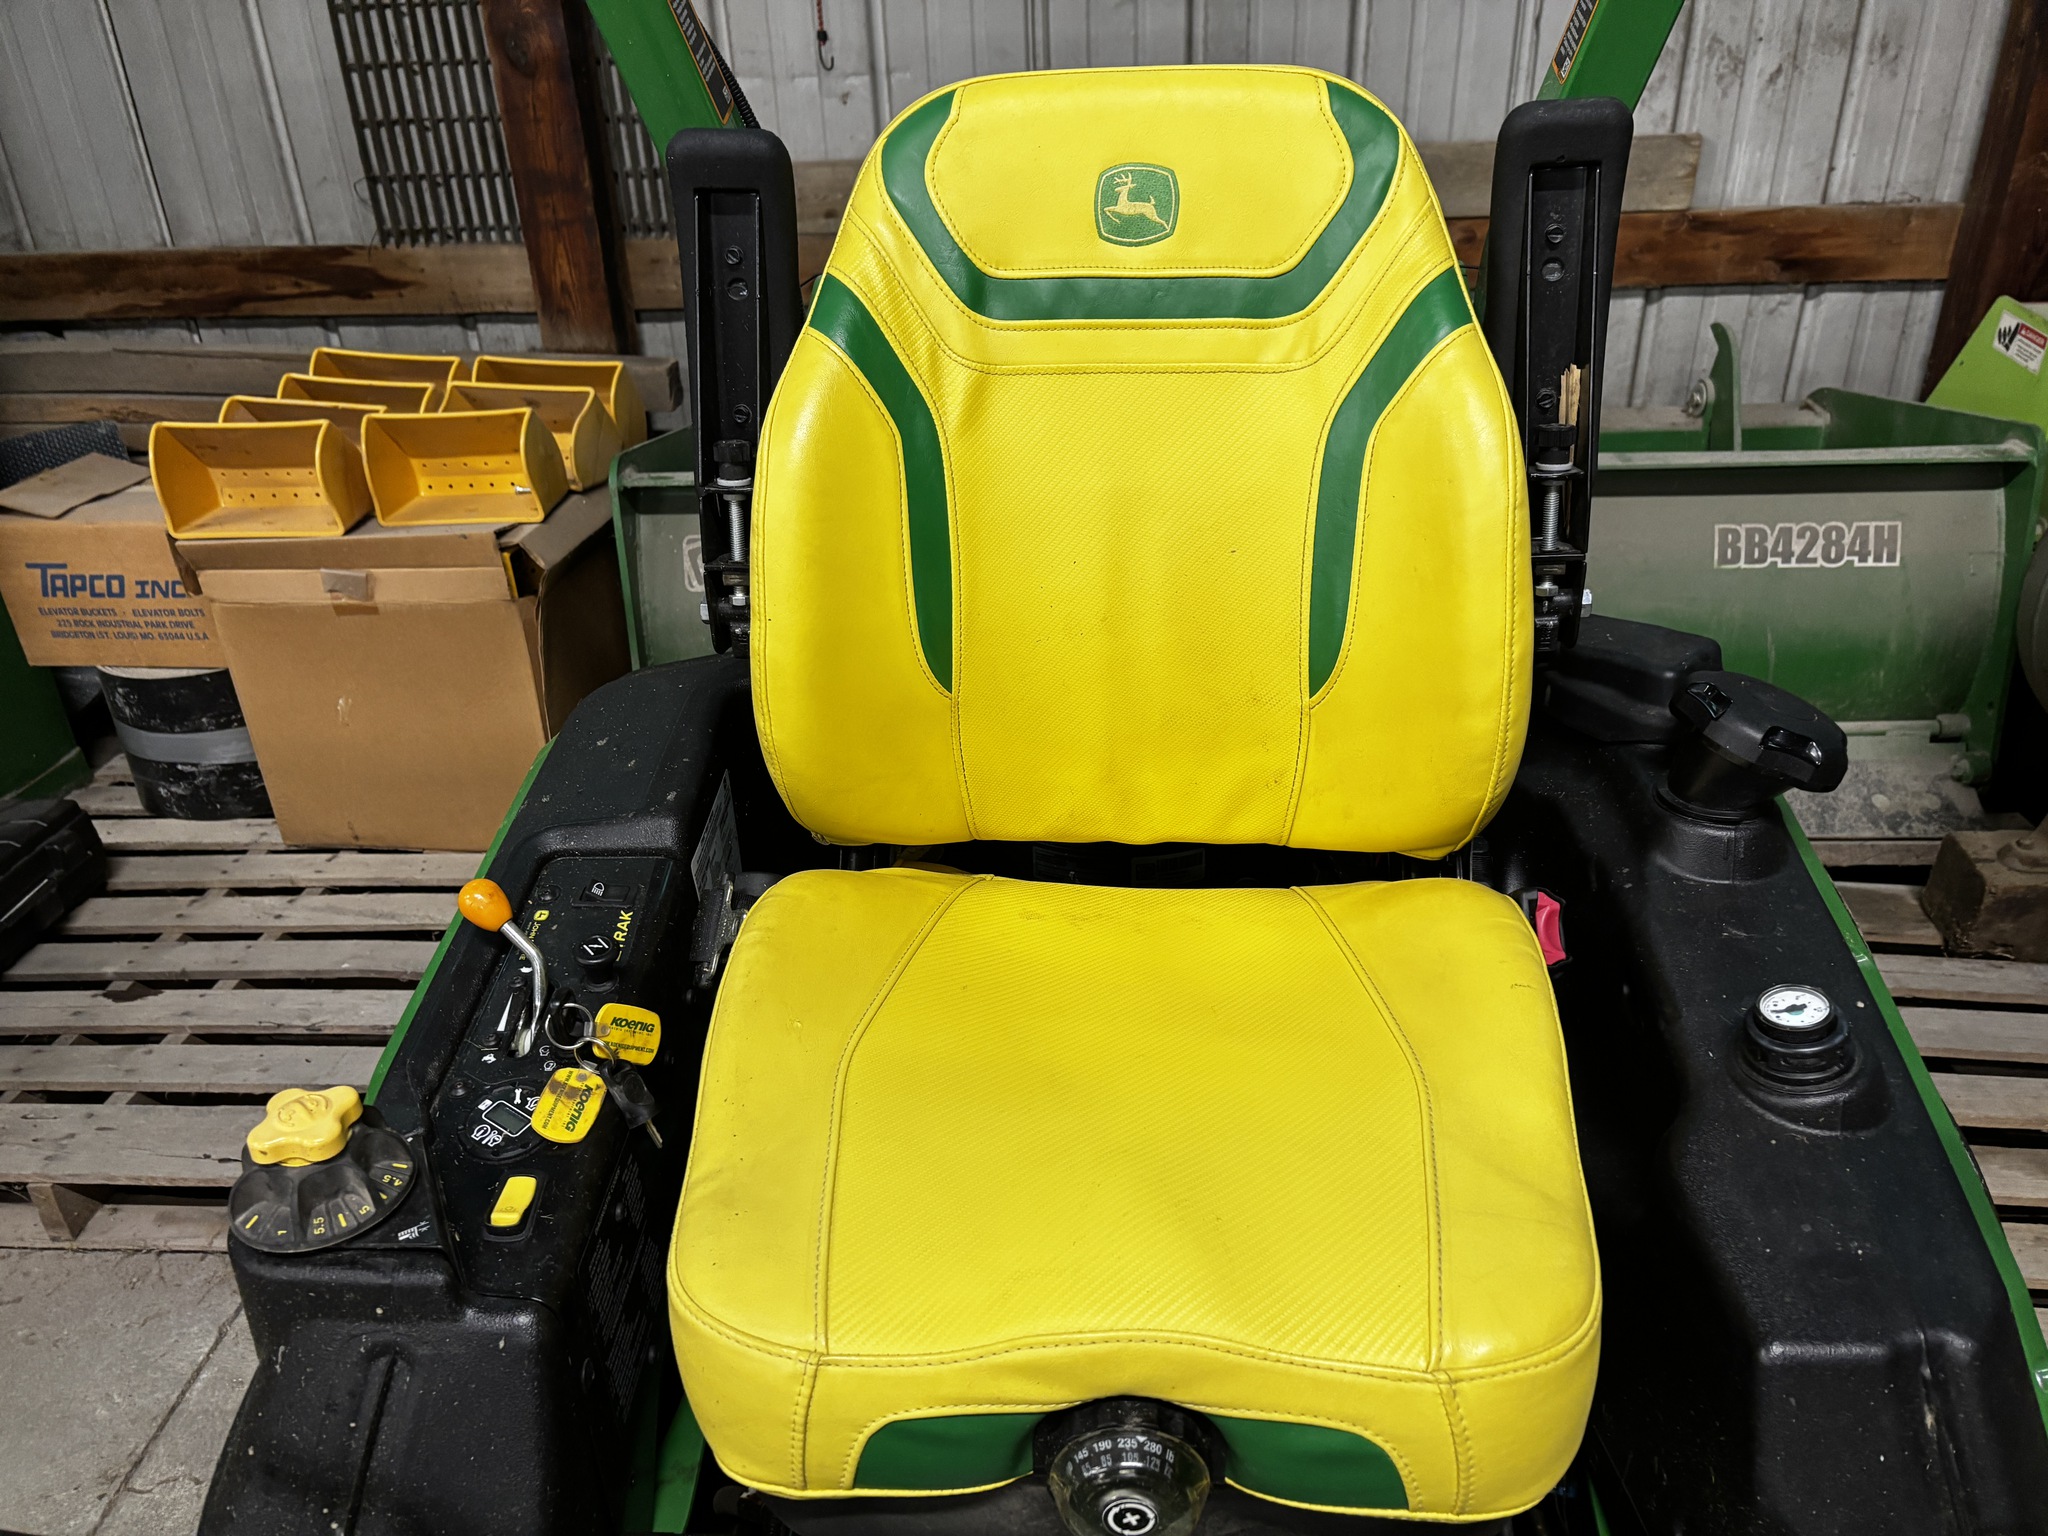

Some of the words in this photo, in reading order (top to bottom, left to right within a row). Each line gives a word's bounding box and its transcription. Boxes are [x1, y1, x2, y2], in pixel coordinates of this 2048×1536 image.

[1714, 521, 1902, 568] BB4284H
[25, 563, 125, 598] TAPCO
[38, 607, 79, 617] ELEVATOR
[80, 608, 118, 617] BUCKETS
[132, 608, 176, 618] ELEVATOR
[177, 608, 206, 618] BOLTS
[73, 619, 95, 628] ROCK
[96, 620, 143, 629] INDUSTRIAL
[144, 621, 168, 630] PARK
[169, 621, 196, 630] DRIVE
[50, 630, 96, 640] BRIDGETON
[529, 921, 541, 939] JOHN
[313, 1217, 325, 1235] 5.5
[1074, 1447, 1089, 1464] 145
[1093, 1439, 1112, 1453] 190
[1117, 1438, 1138, 1450] 235
[1143, 1440, 1162, 1455] 280
[1166, 1449, 1174, 1464] lb
[1101, 1454, 1113, 1467] 85
[1122, 1452, 1139, 1463] 105
